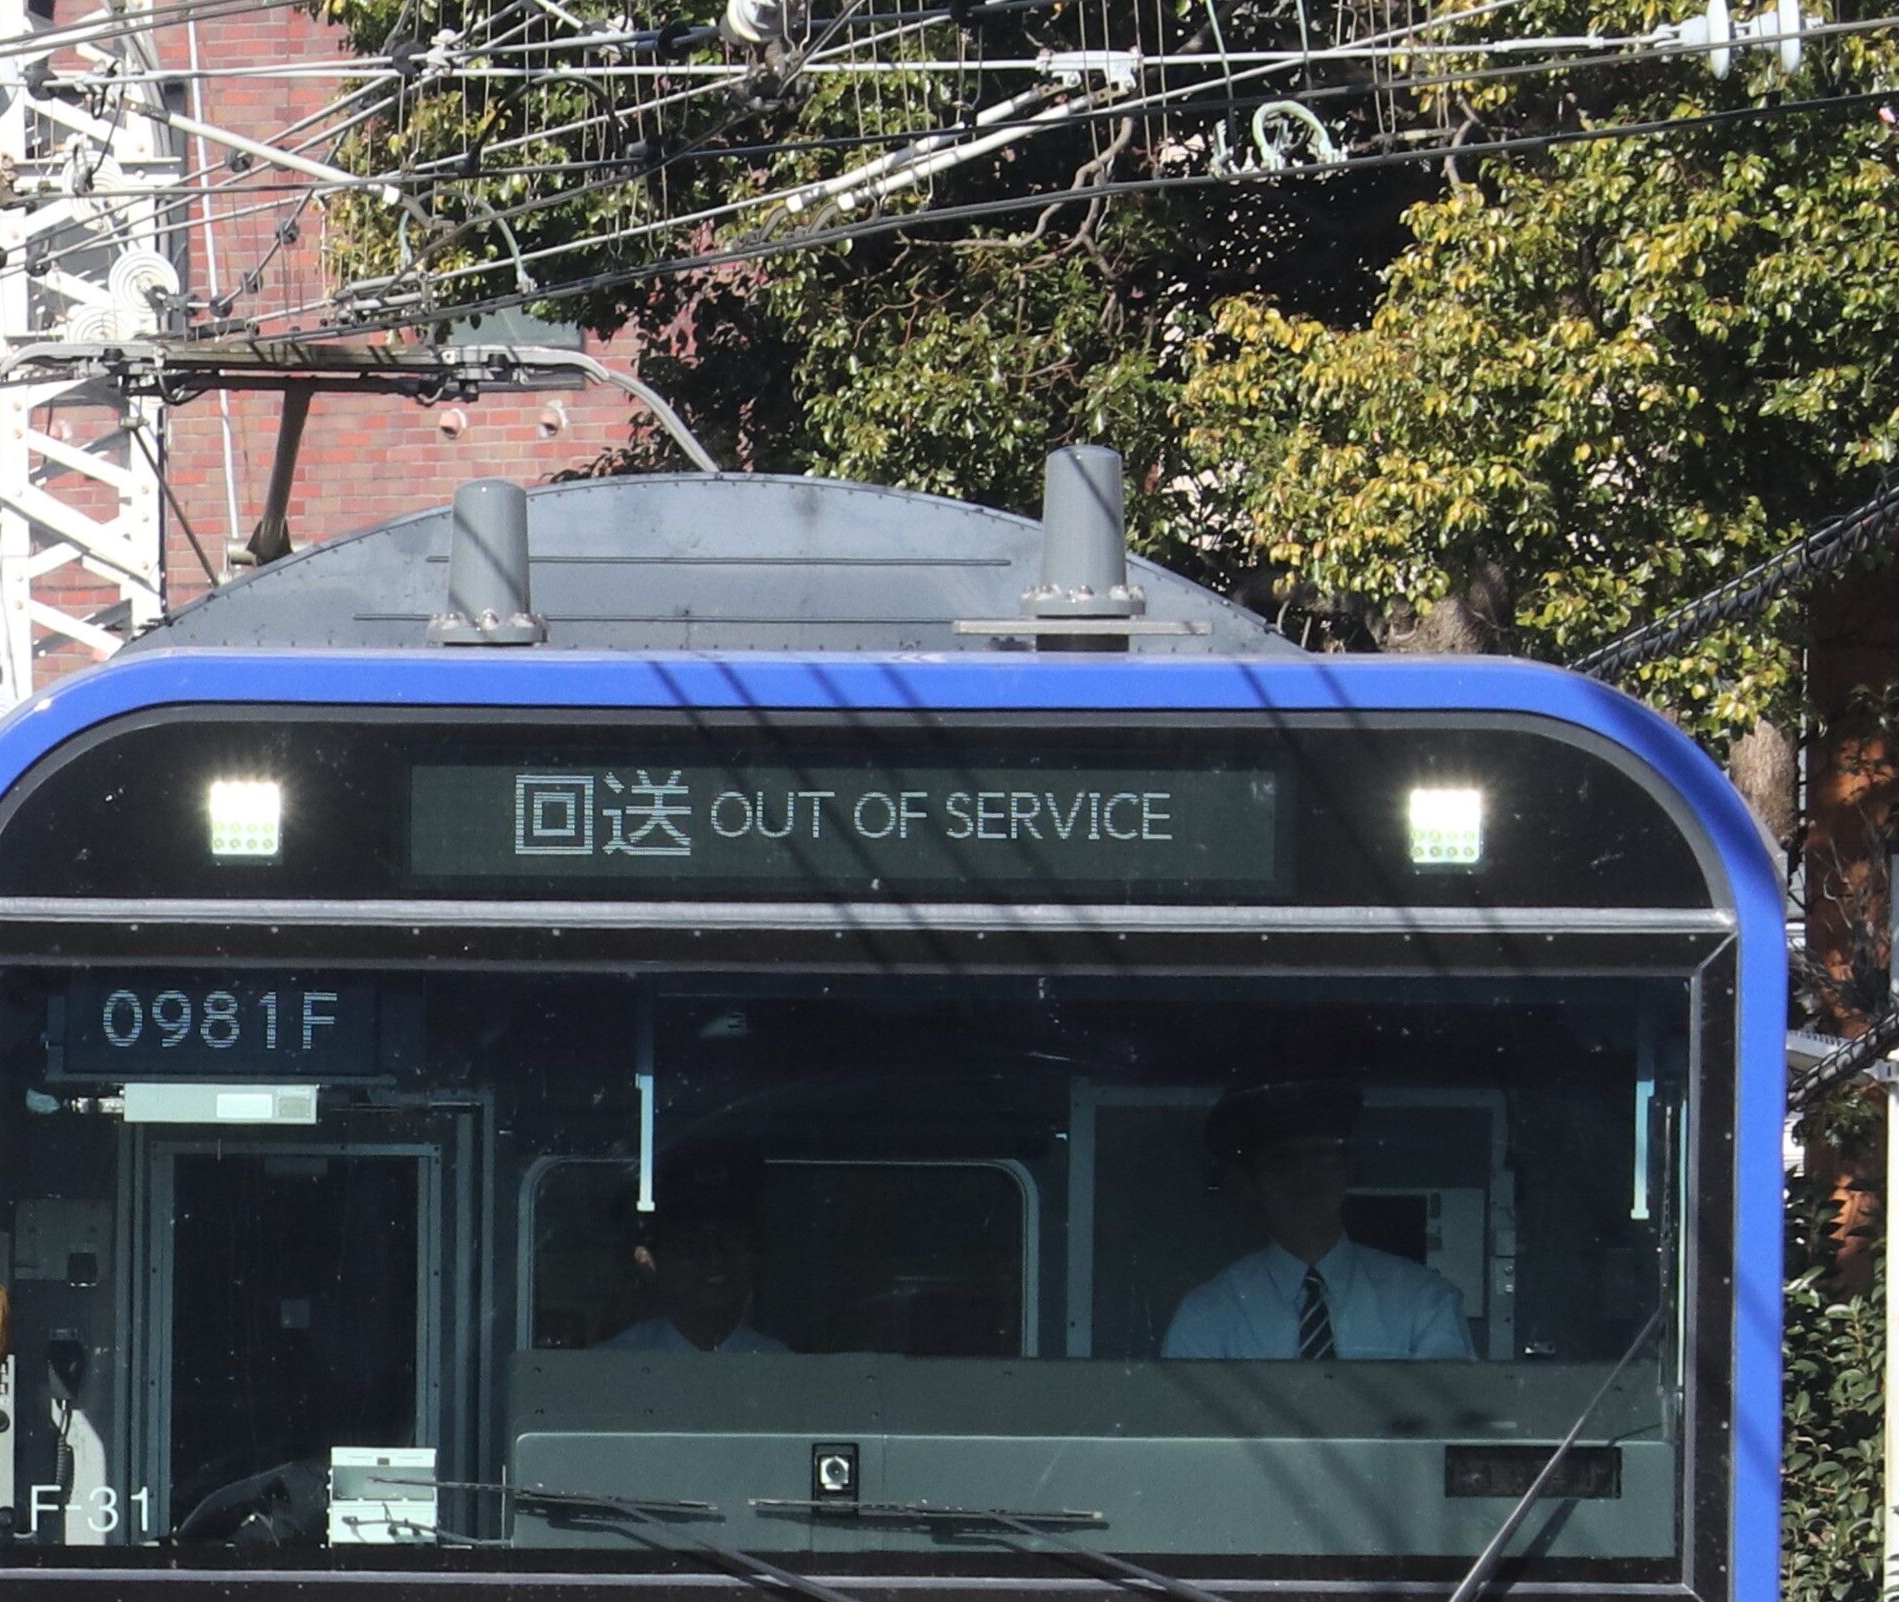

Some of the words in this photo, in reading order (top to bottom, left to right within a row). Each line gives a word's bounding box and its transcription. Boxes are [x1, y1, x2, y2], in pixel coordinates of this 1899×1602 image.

[514, 769, 692, 856] 回送
[710, 791, 835, 839] OUT
[853, 791, 928, 839] OF
[945, 791, 1174, 841] SERVICE
[102, 988, 338, 1050] 0981F
[29, 1484, 150, 1533] F-31
